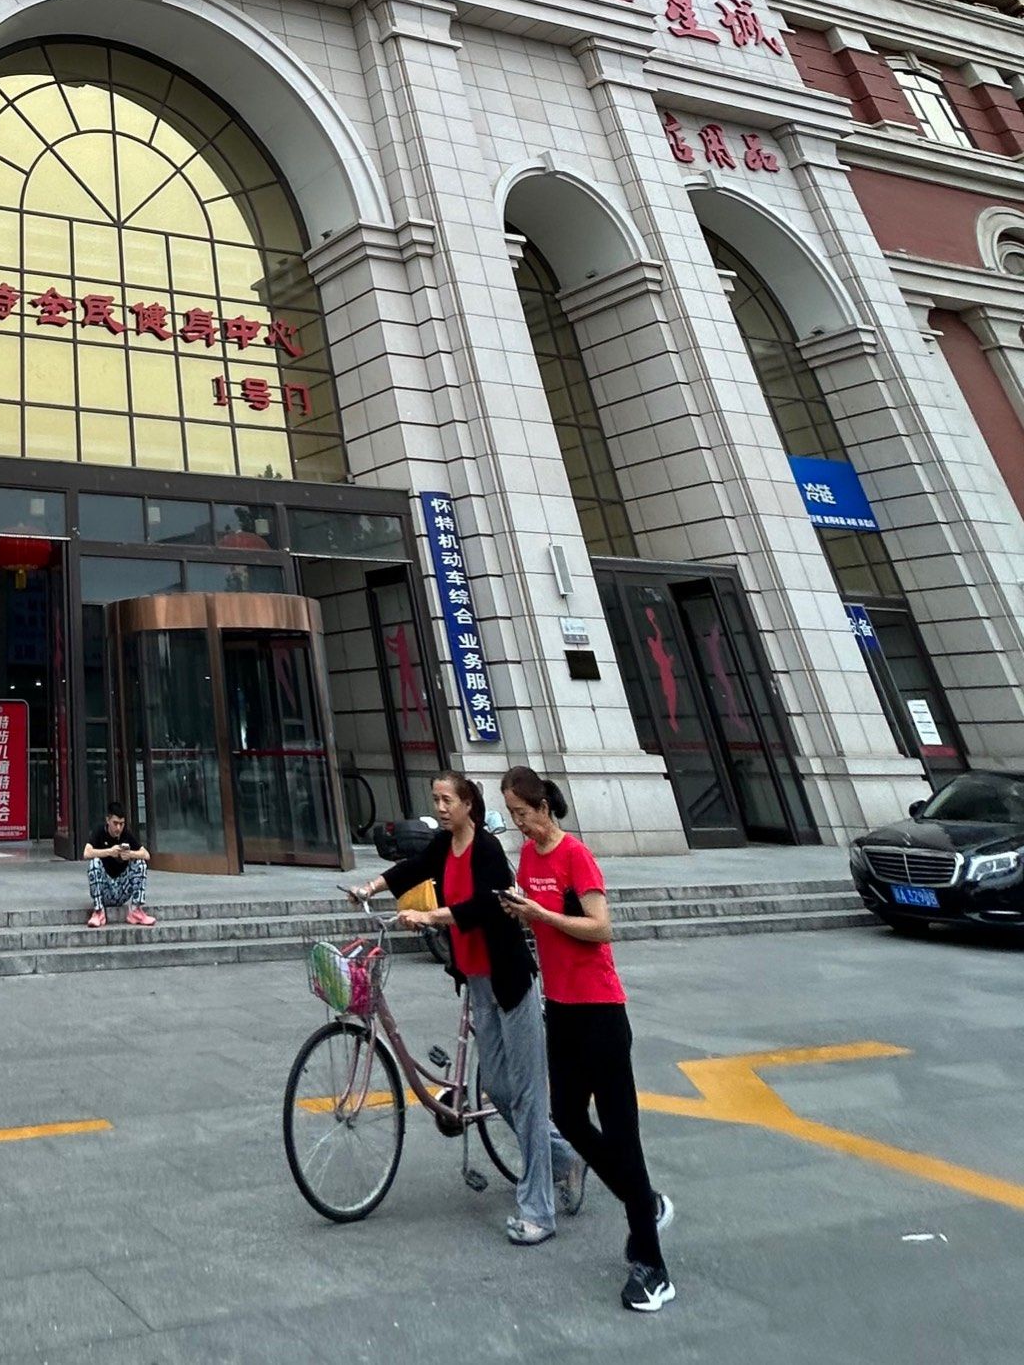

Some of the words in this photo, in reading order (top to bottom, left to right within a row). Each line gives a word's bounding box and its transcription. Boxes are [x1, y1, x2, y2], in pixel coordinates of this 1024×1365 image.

[213, 375, 311, 416] 1号门
[431, 496, 496, 733] 怀特机动车综合业务服务站
